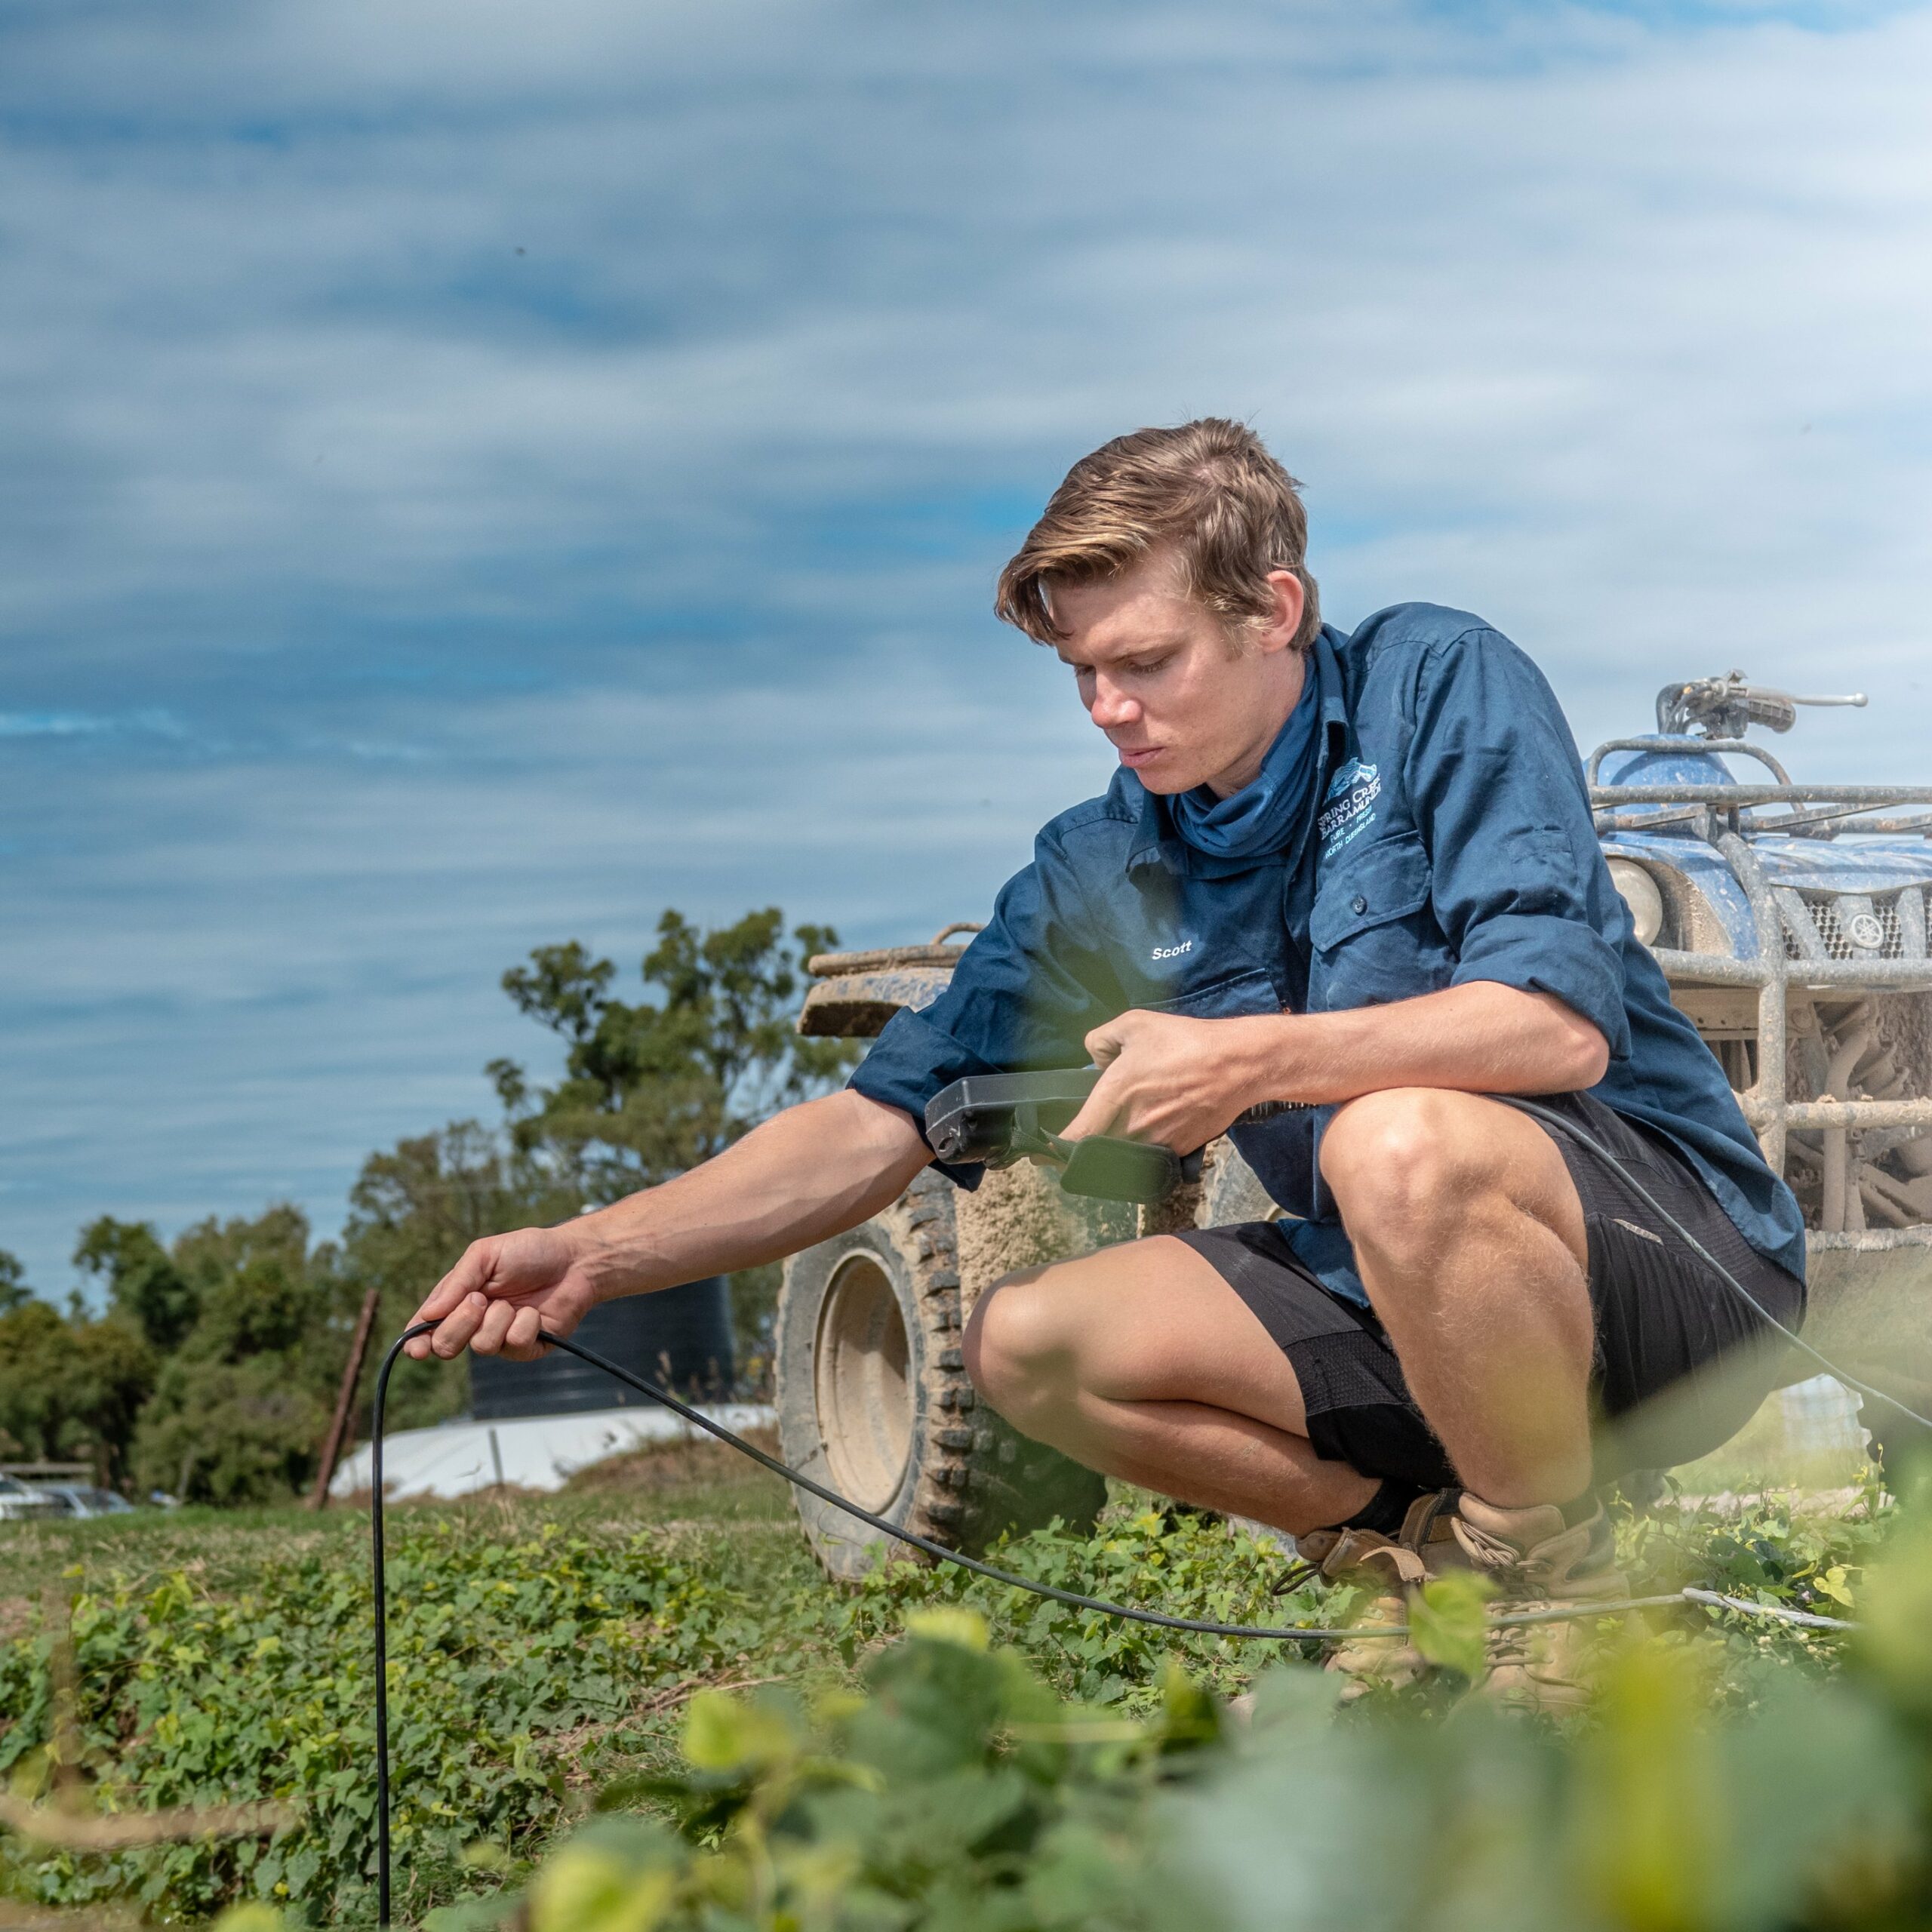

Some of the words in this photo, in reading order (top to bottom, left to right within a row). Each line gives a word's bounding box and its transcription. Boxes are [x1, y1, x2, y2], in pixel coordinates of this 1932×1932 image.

[1330, 827, 1346, 843] PURE
[1324, 840, 1343, 859] NORTH
[1152, 940, 1192, 960] Scott
